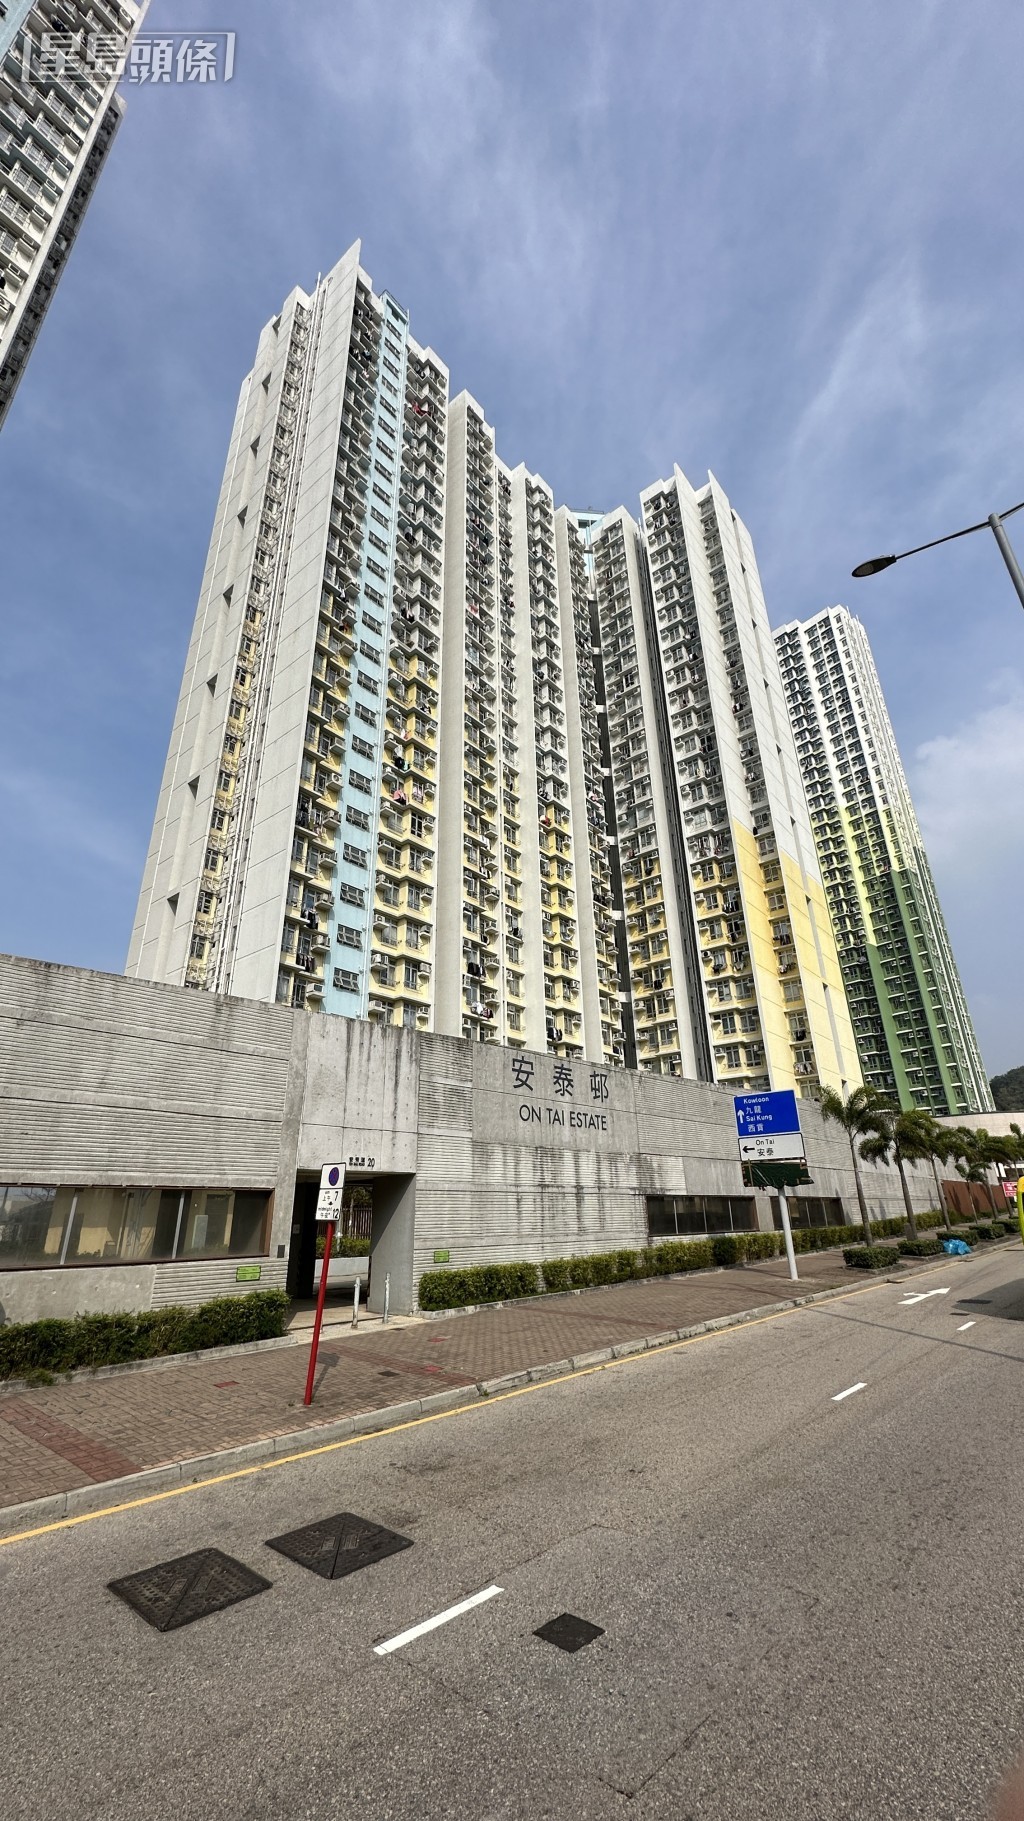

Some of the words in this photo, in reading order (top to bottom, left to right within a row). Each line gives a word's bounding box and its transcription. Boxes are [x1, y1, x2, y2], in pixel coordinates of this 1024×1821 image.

[512, 1056, 609, 1103] 安泰邨
[745, 1105, 762, 1114] 九龍
[519, 1104, 542, 1123] ON
[546, 1107, 565, 1126] TAI
[569, 1110, 607, 1131] ESTATE
[747, 1123, 764, 1133] 西貢
[757, 1147, 774, 1157] 安泰
[367, 1157, 375, 1168] 20
[334, 1190, 339, 1202] 7
[332, 1208, 340, 1219] 12
